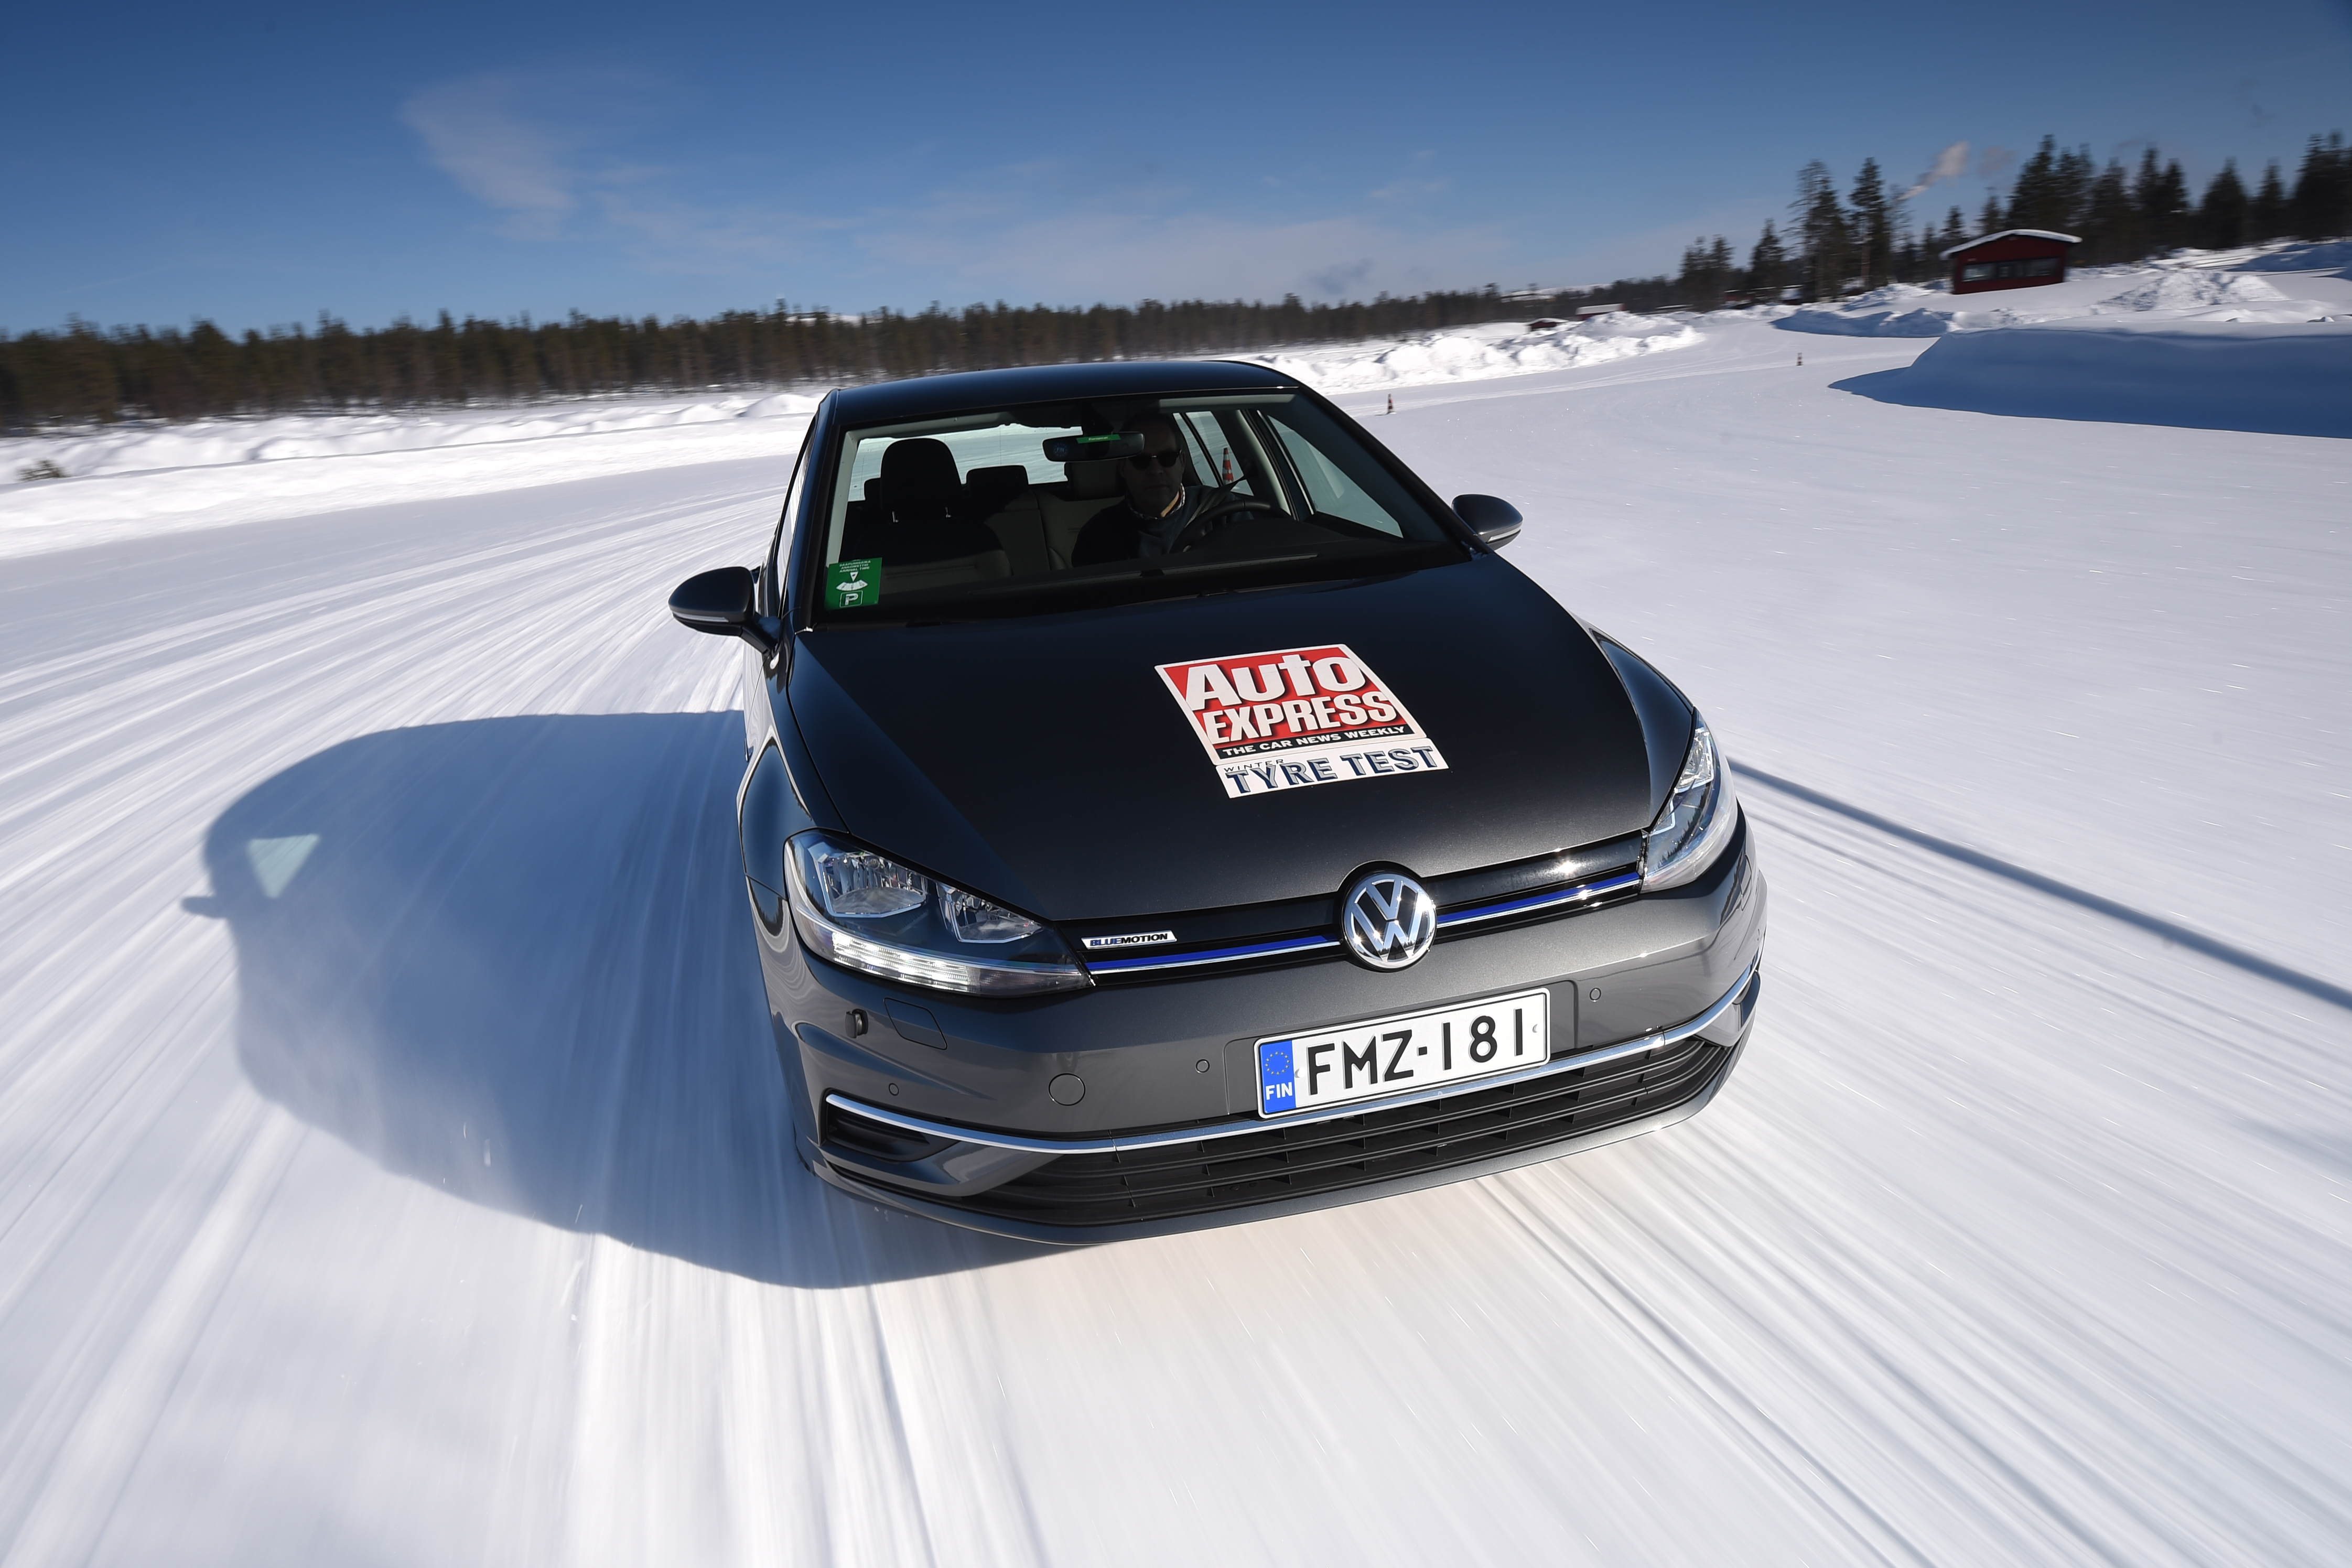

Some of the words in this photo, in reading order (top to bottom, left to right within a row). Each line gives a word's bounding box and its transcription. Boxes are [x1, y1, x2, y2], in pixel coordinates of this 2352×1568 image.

[845, 593, 859, 605] P
[1185, 654, 1366, 711] Auto
[1202, 690, 1397, 744] EXPRESS
[1222, 745, 1256, 756] THE
[1259, 740, 1293, 750] CAR
[1296, 733, 1342, 745] NEWS
[1344, 726, 1405, 739] WEEKLY
[1223, 759, 1285, 772] WINTER
[1225, 758, 1339, 794] TYRE
[1340, 745, 1438, 776] TEST
[1089, 933, 1168, 947] BLUEMOTION
[1346, 877, 1432, 965] VW
[1307, 1008, 1523, 1096] FMZ-181
[1265, 1082, 1293, 1101] FIN
